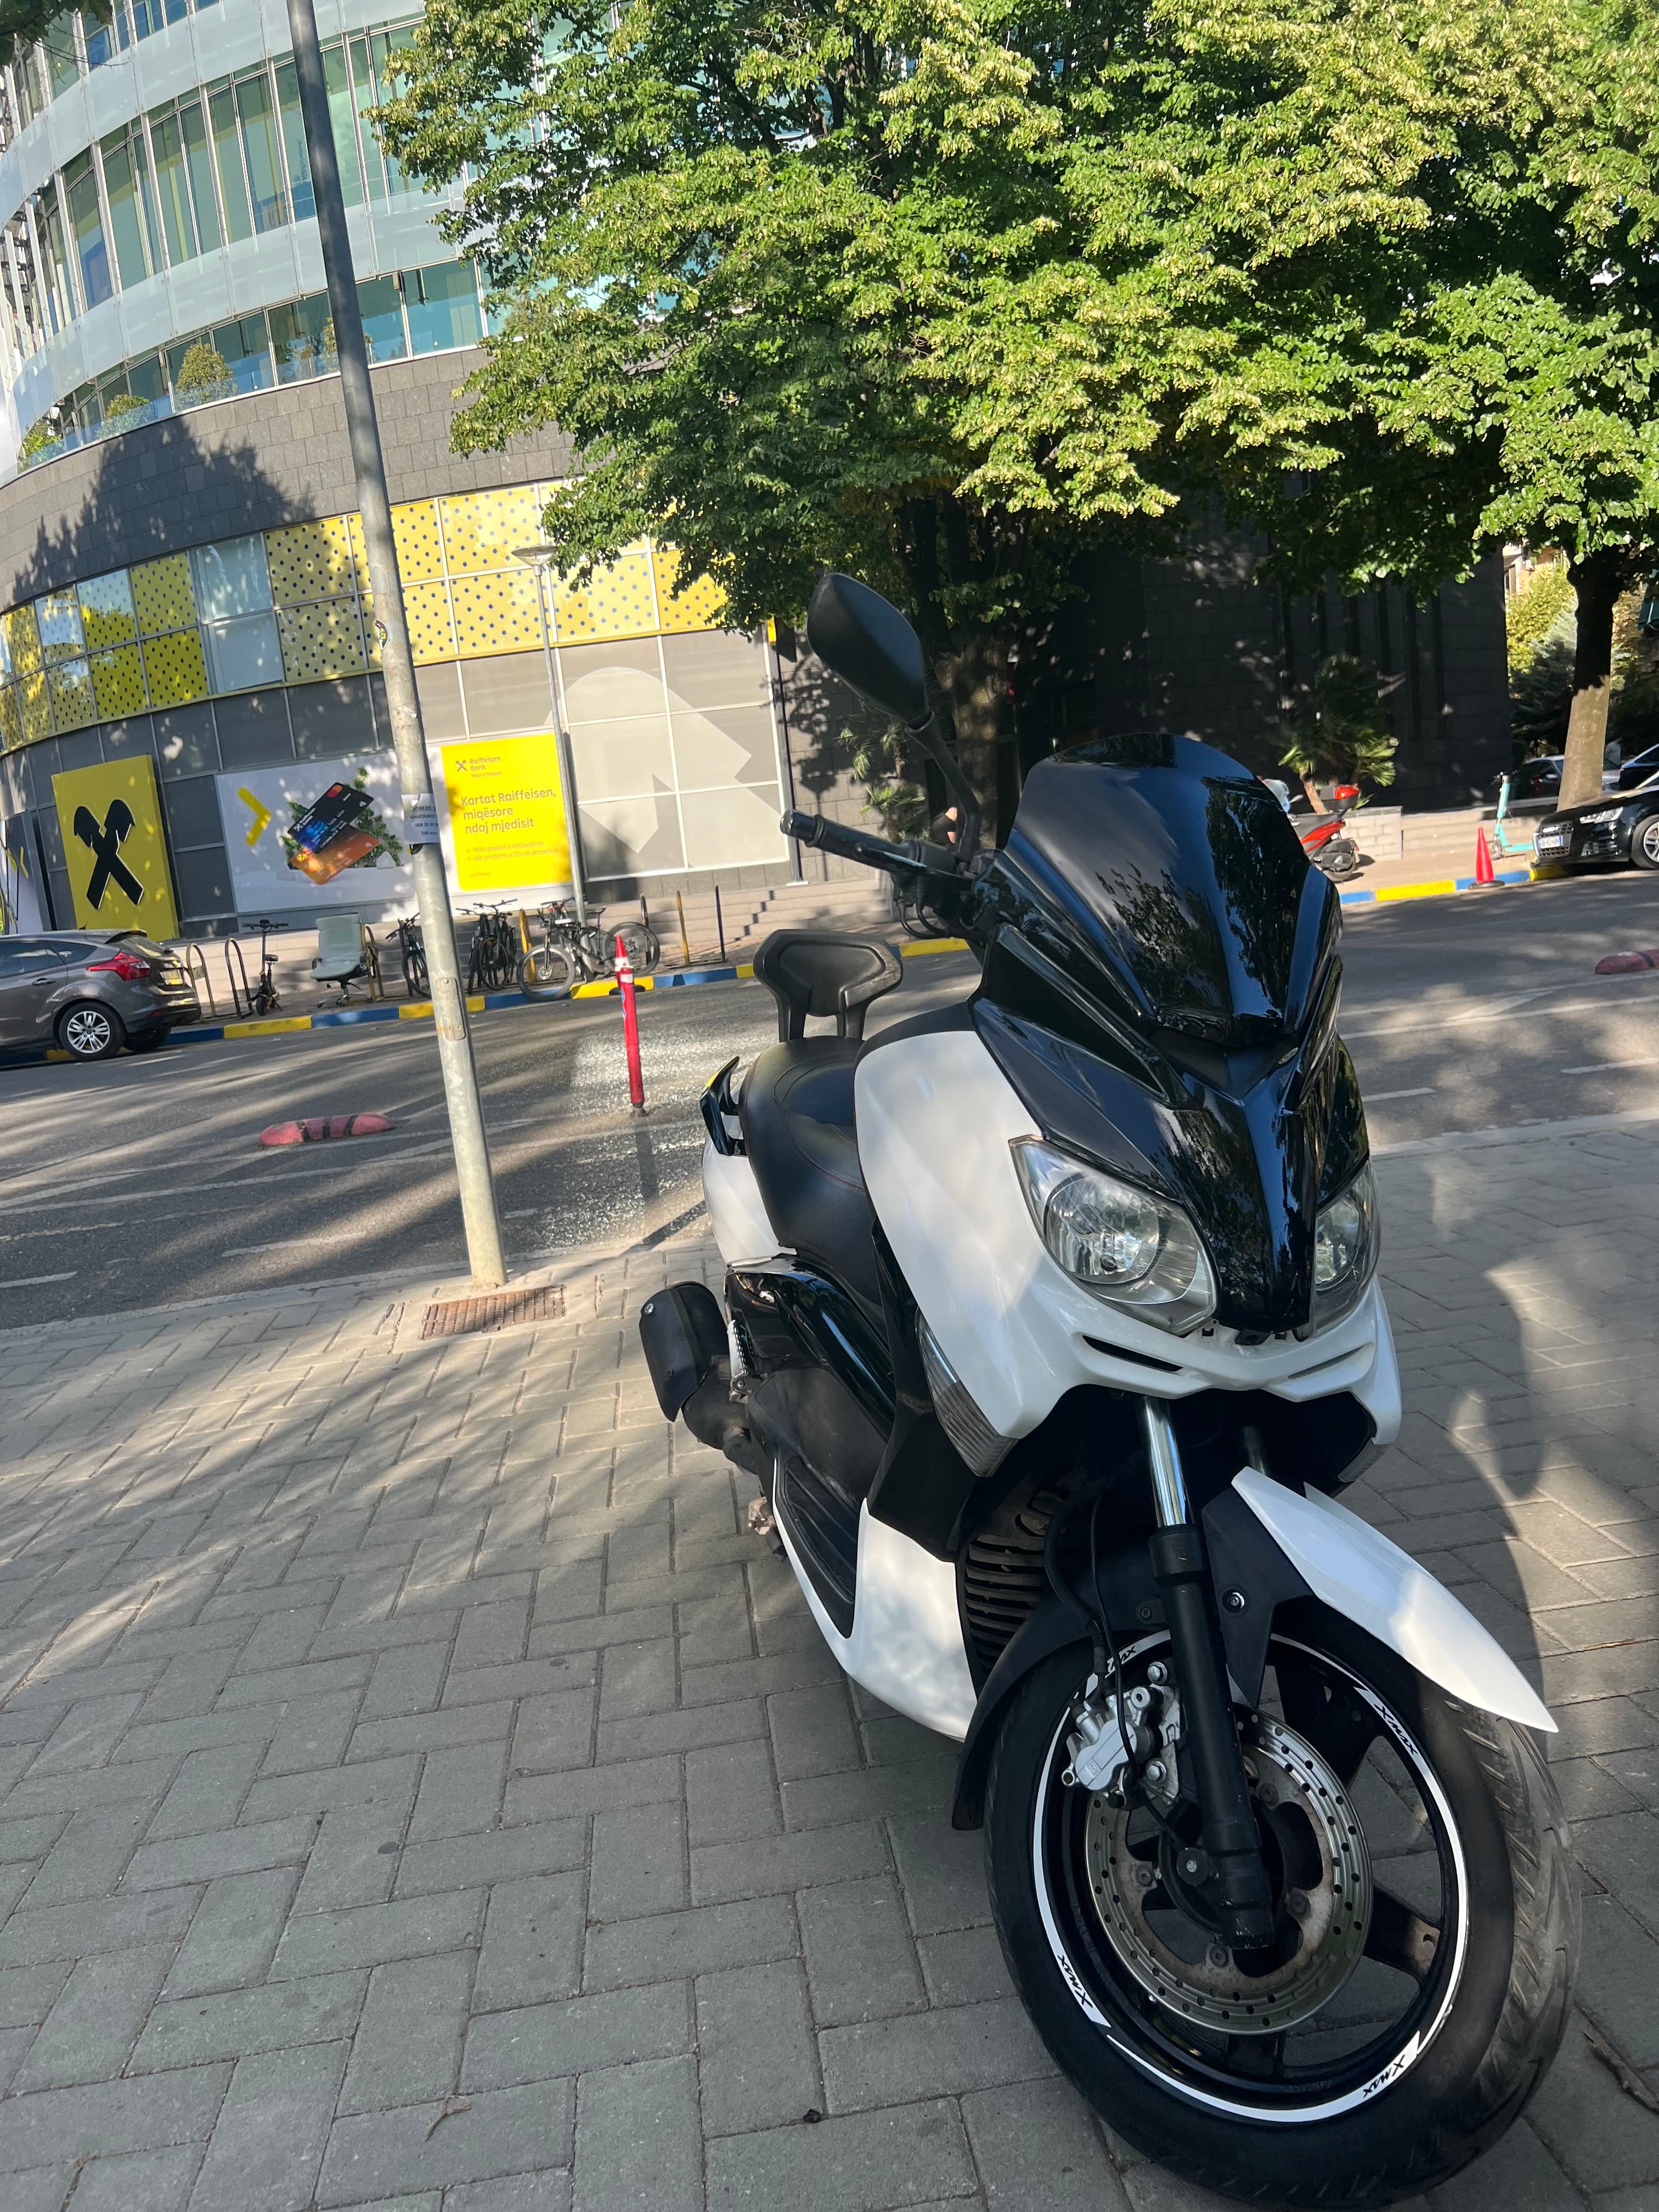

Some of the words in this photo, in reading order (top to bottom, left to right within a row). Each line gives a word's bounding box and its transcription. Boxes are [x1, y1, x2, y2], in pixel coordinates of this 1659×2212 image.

[469, 756, 500, 764] Raiffeisen
[461, 793, 496, 806] Kartat
[498, 788, 557, 803] Raiffeisen,
[463, 807, 514, 821] miqësore
[465, 822, 489, 834] ndaj
[491, 817, 535, 833] mjedisit
